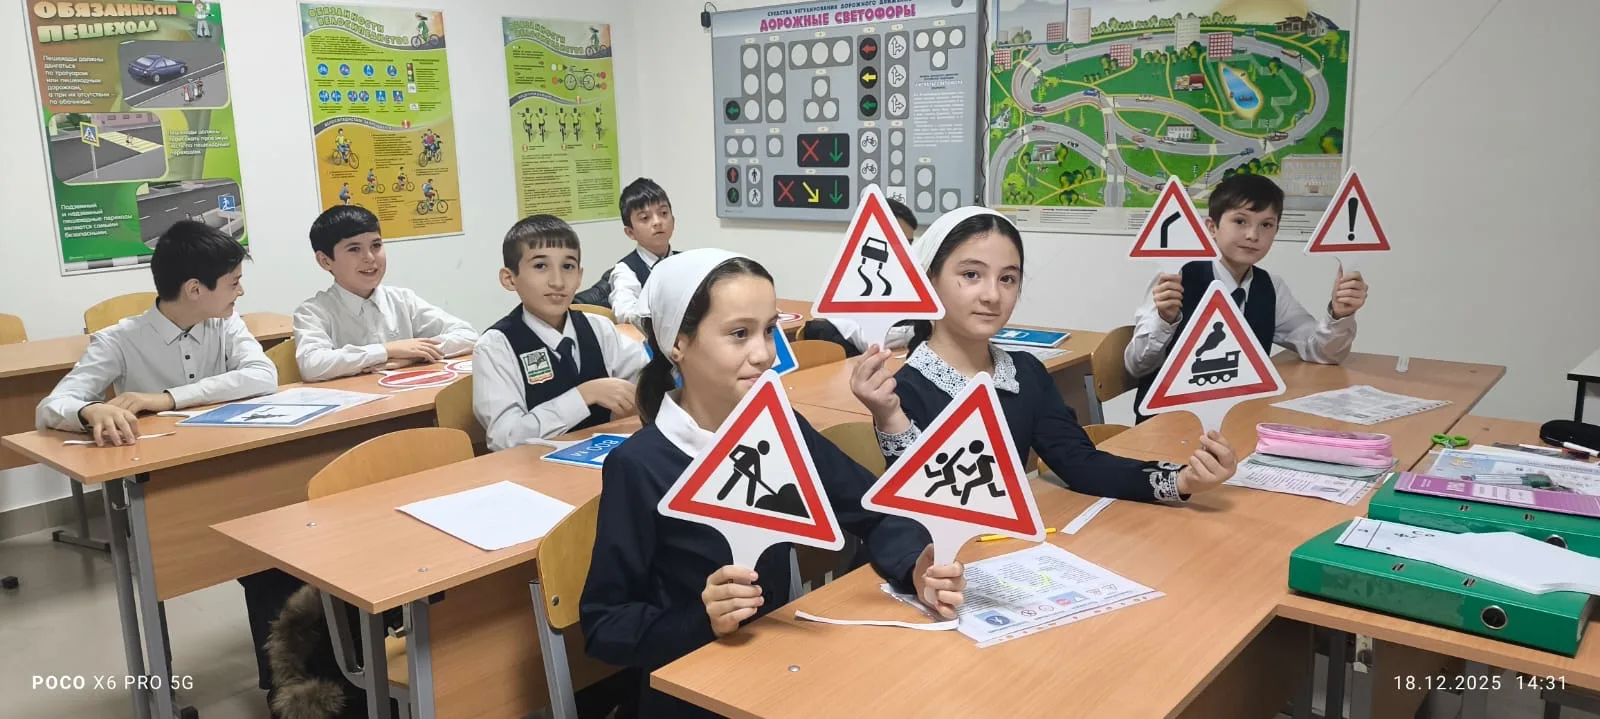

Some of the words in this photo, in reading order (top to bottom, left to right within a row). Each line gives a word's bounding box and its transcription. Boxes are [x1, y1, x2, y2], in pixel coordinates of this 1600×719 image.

[33, 1, 177, 19] ОБЯЗАННОСТИ
[308, 7, 384, 33] ОБЯЗАННОСТИ
[759, 12, 830, 32] ДОРОЖНЫЕ
[834, 4, 916, 24] СВЕТОФОРЫ
[767, 9, 793, 17] СРЕДСТВА
[840, 0, 877, 9] ДОРОЖНОГО
[37, 20, 158, 43] ПЕШЕХОДА
